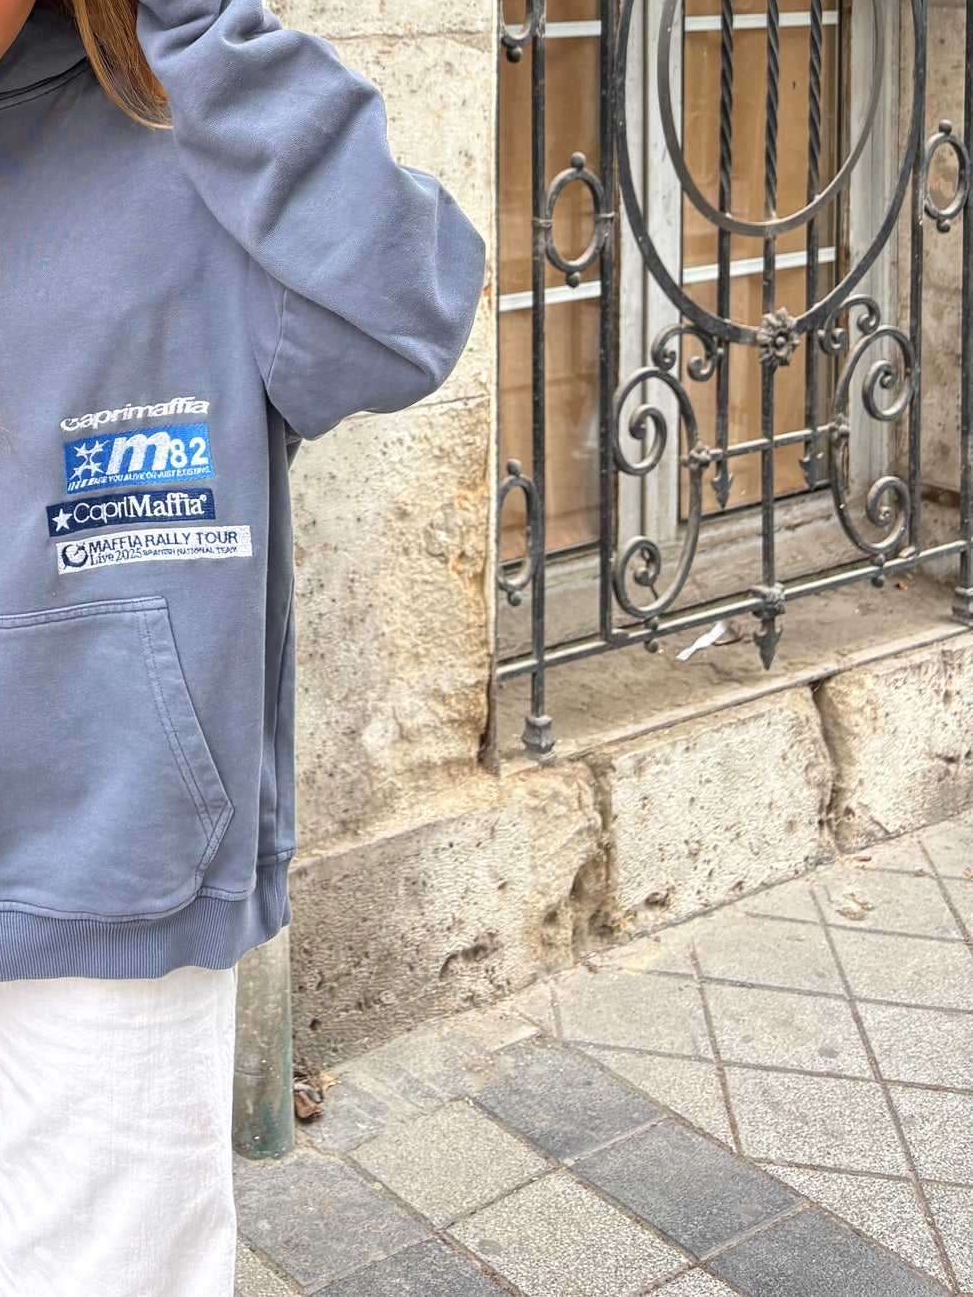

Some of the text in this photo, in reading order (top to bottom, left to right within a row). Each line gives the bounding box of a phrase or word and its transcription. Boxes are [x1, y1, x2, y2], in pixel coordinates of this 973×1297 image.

[108, 473, 124, 482] YOU
[124, 471, 145, 481] ALIVE
[145, 471, 157, 479] OR
[157, 469, 175, 478] JUST
[88, 531, 239, 554] MAFFIA RALLY TOUR
[89, 552, 114, 566] Live
[116, 548, 142, 562] 2025
[216, 546, 238, 554] TEAM
